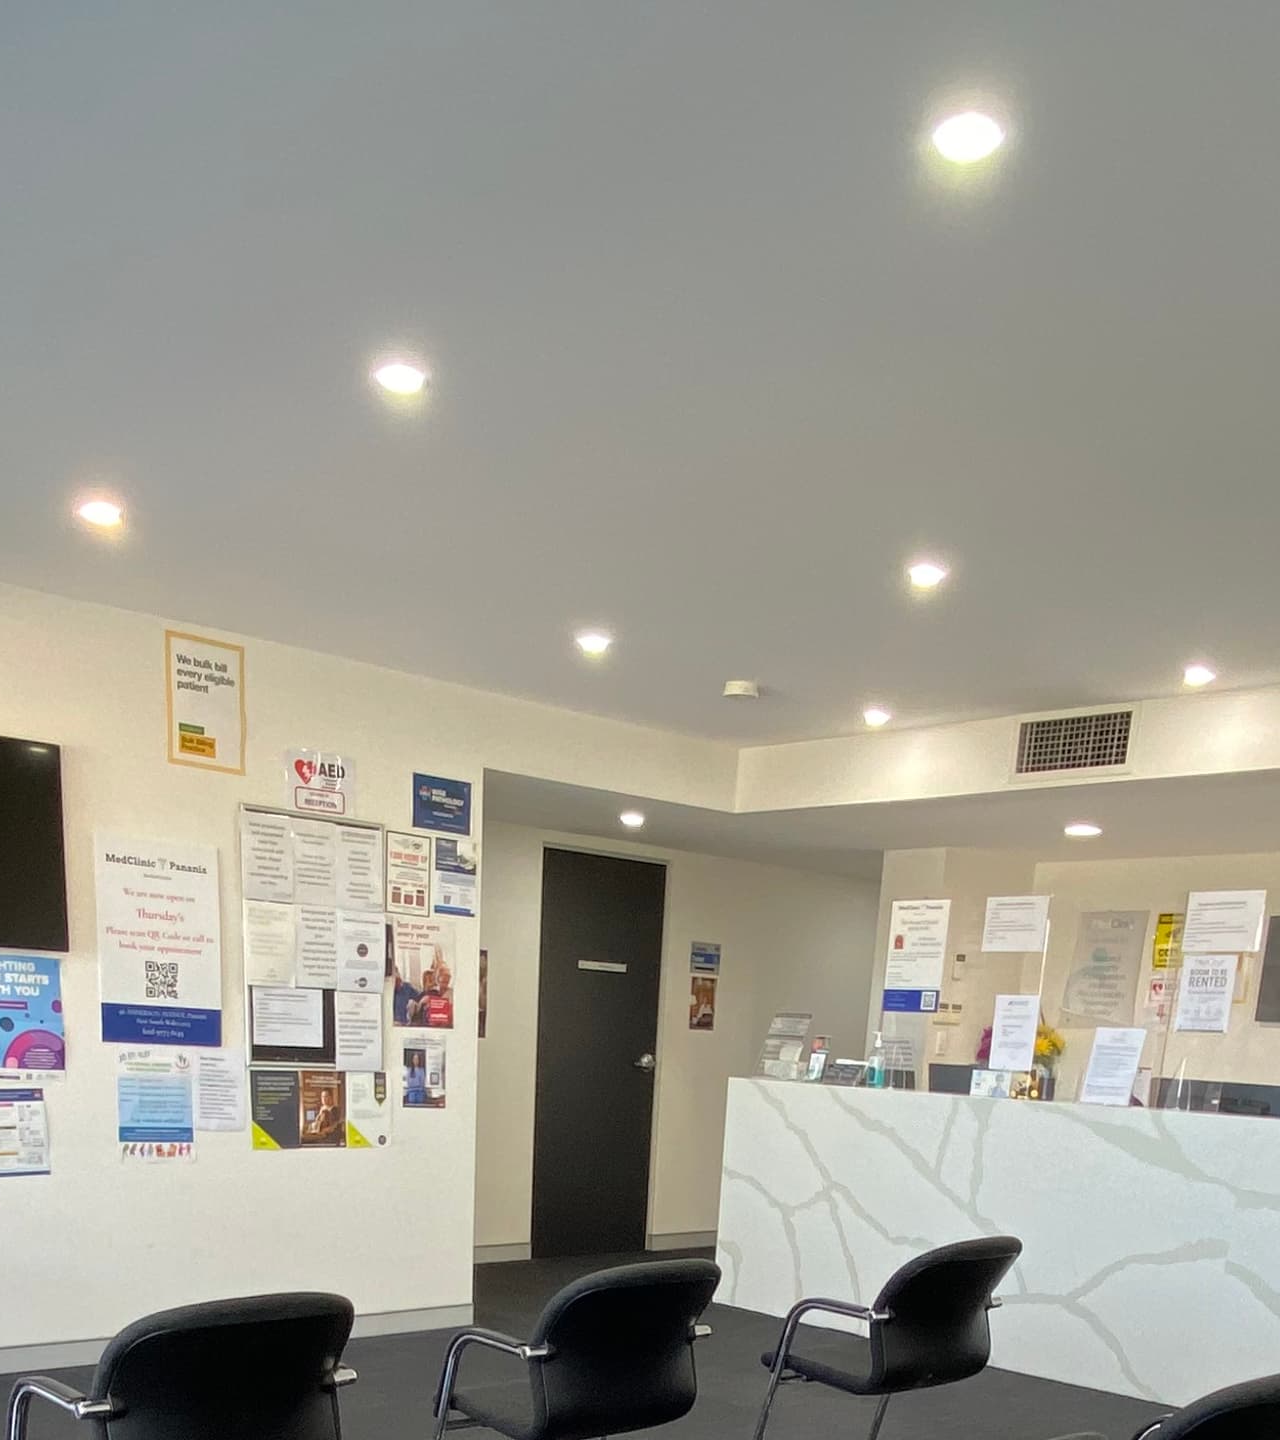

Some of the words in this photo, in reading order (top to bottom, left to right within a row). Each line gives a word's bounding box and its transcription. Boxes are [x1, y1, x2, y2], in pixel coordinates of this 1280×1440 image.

[176, 653, 191, 666] We
[193, 657, 213, 670] bulk
[214, 662, 227, 674] bill
[176, 668, 202, 682] every
[204, 673, 235, 688] eligible
[177, 679, 209, 694] patient
[318, 763, 345, 779] AED
[105, 853, 156, 868] MedClinic
[169, 861, 208, 874] Panania
[123, 887, 134, 896] We
[166, 894, 184, 903] open
[136, 908, 185, 924] Thursday's
[105, 926, 128, 935] Please
[147, 930, 161, 940] QR
[162, 932, 181, 941] Code
[192, 934, 205, 943] call
[410, 923, 425, 932] your
[397, 931, 415, 940] every
[416, 932, 429, 941] year
[118, 940, 137, 950] book
[139, 944, 155, 952] your
[4, 973, 49, 986] STARTS
[1188, 976, 1228, 988] RENTED
[15, 985, 40, 997] YOU
